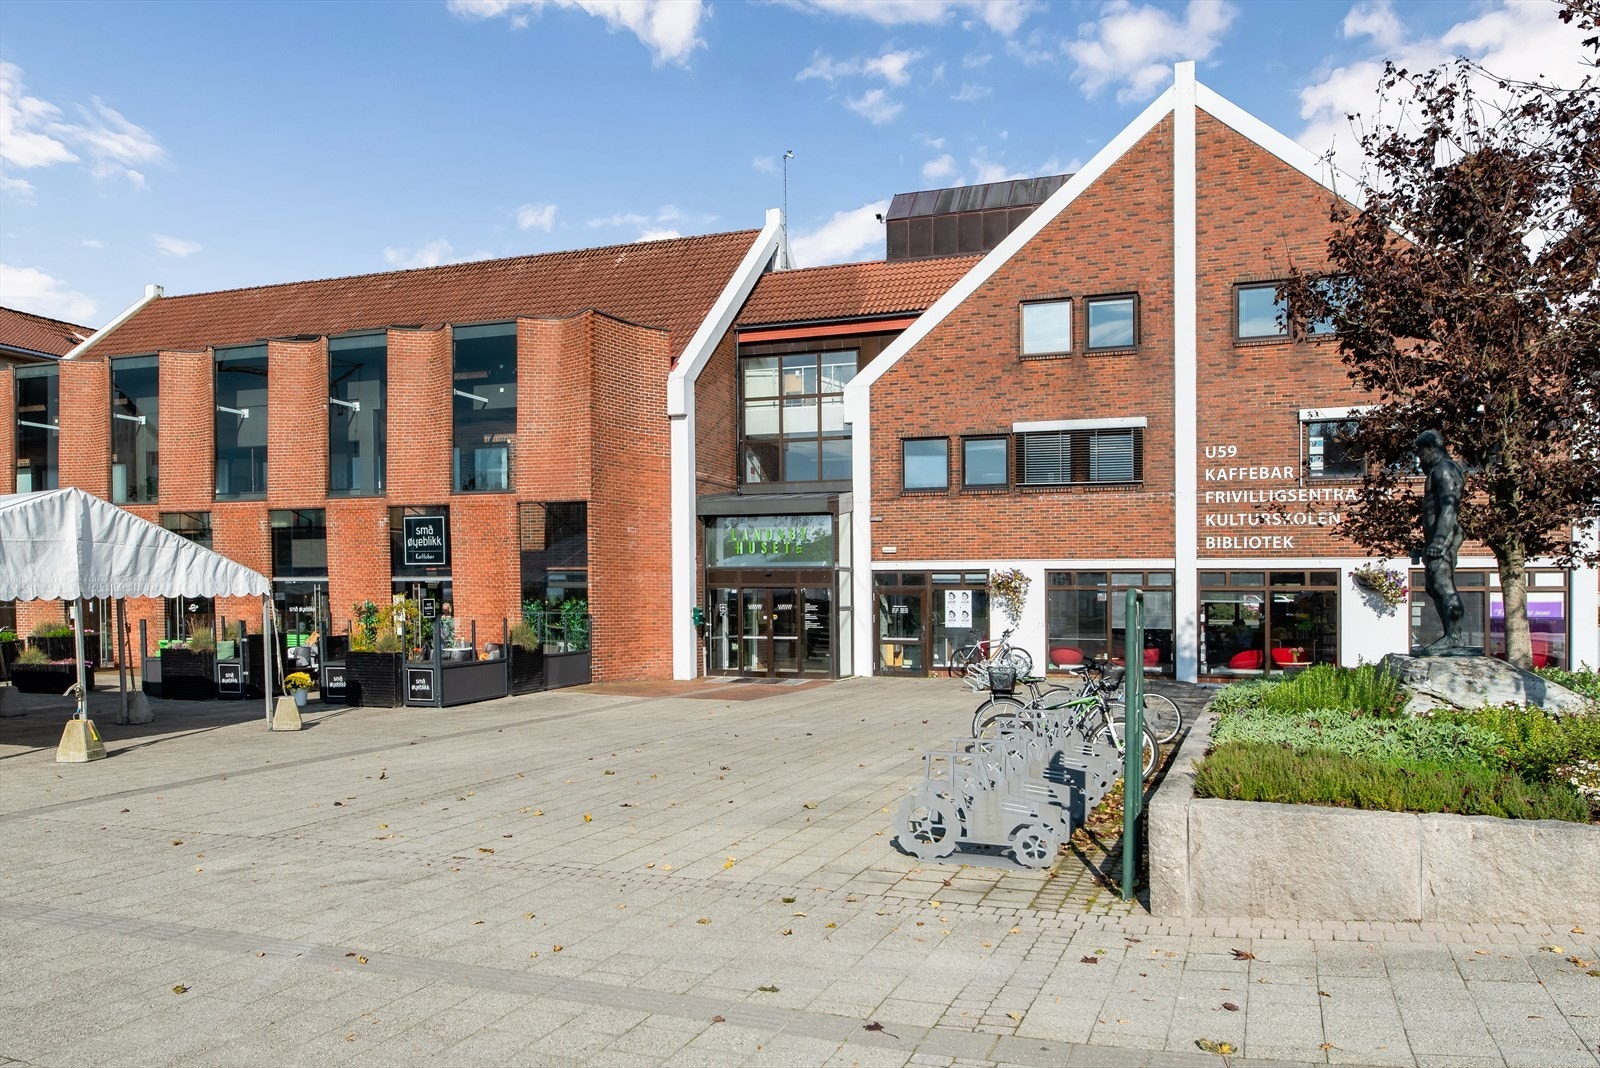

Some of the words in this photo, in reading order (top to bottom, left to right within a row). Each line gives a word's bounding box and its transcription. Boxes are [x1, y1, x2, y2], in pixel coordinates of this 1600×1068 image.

[1205, 445, 1237, 458] U59
[1205, 466, 1294, 481] KAFFEBAR
[1205, 511, 1341, 527] KULTURSKOLEN
[415, 524, 434, 535] små
[731, 527, 808, 541] LANDSBY
[407, 535, 442, 549] øyeblikk
[736, 541, 790, 554] HUSET
[1205, 535, 1294, 549] BIBLIOTEK
